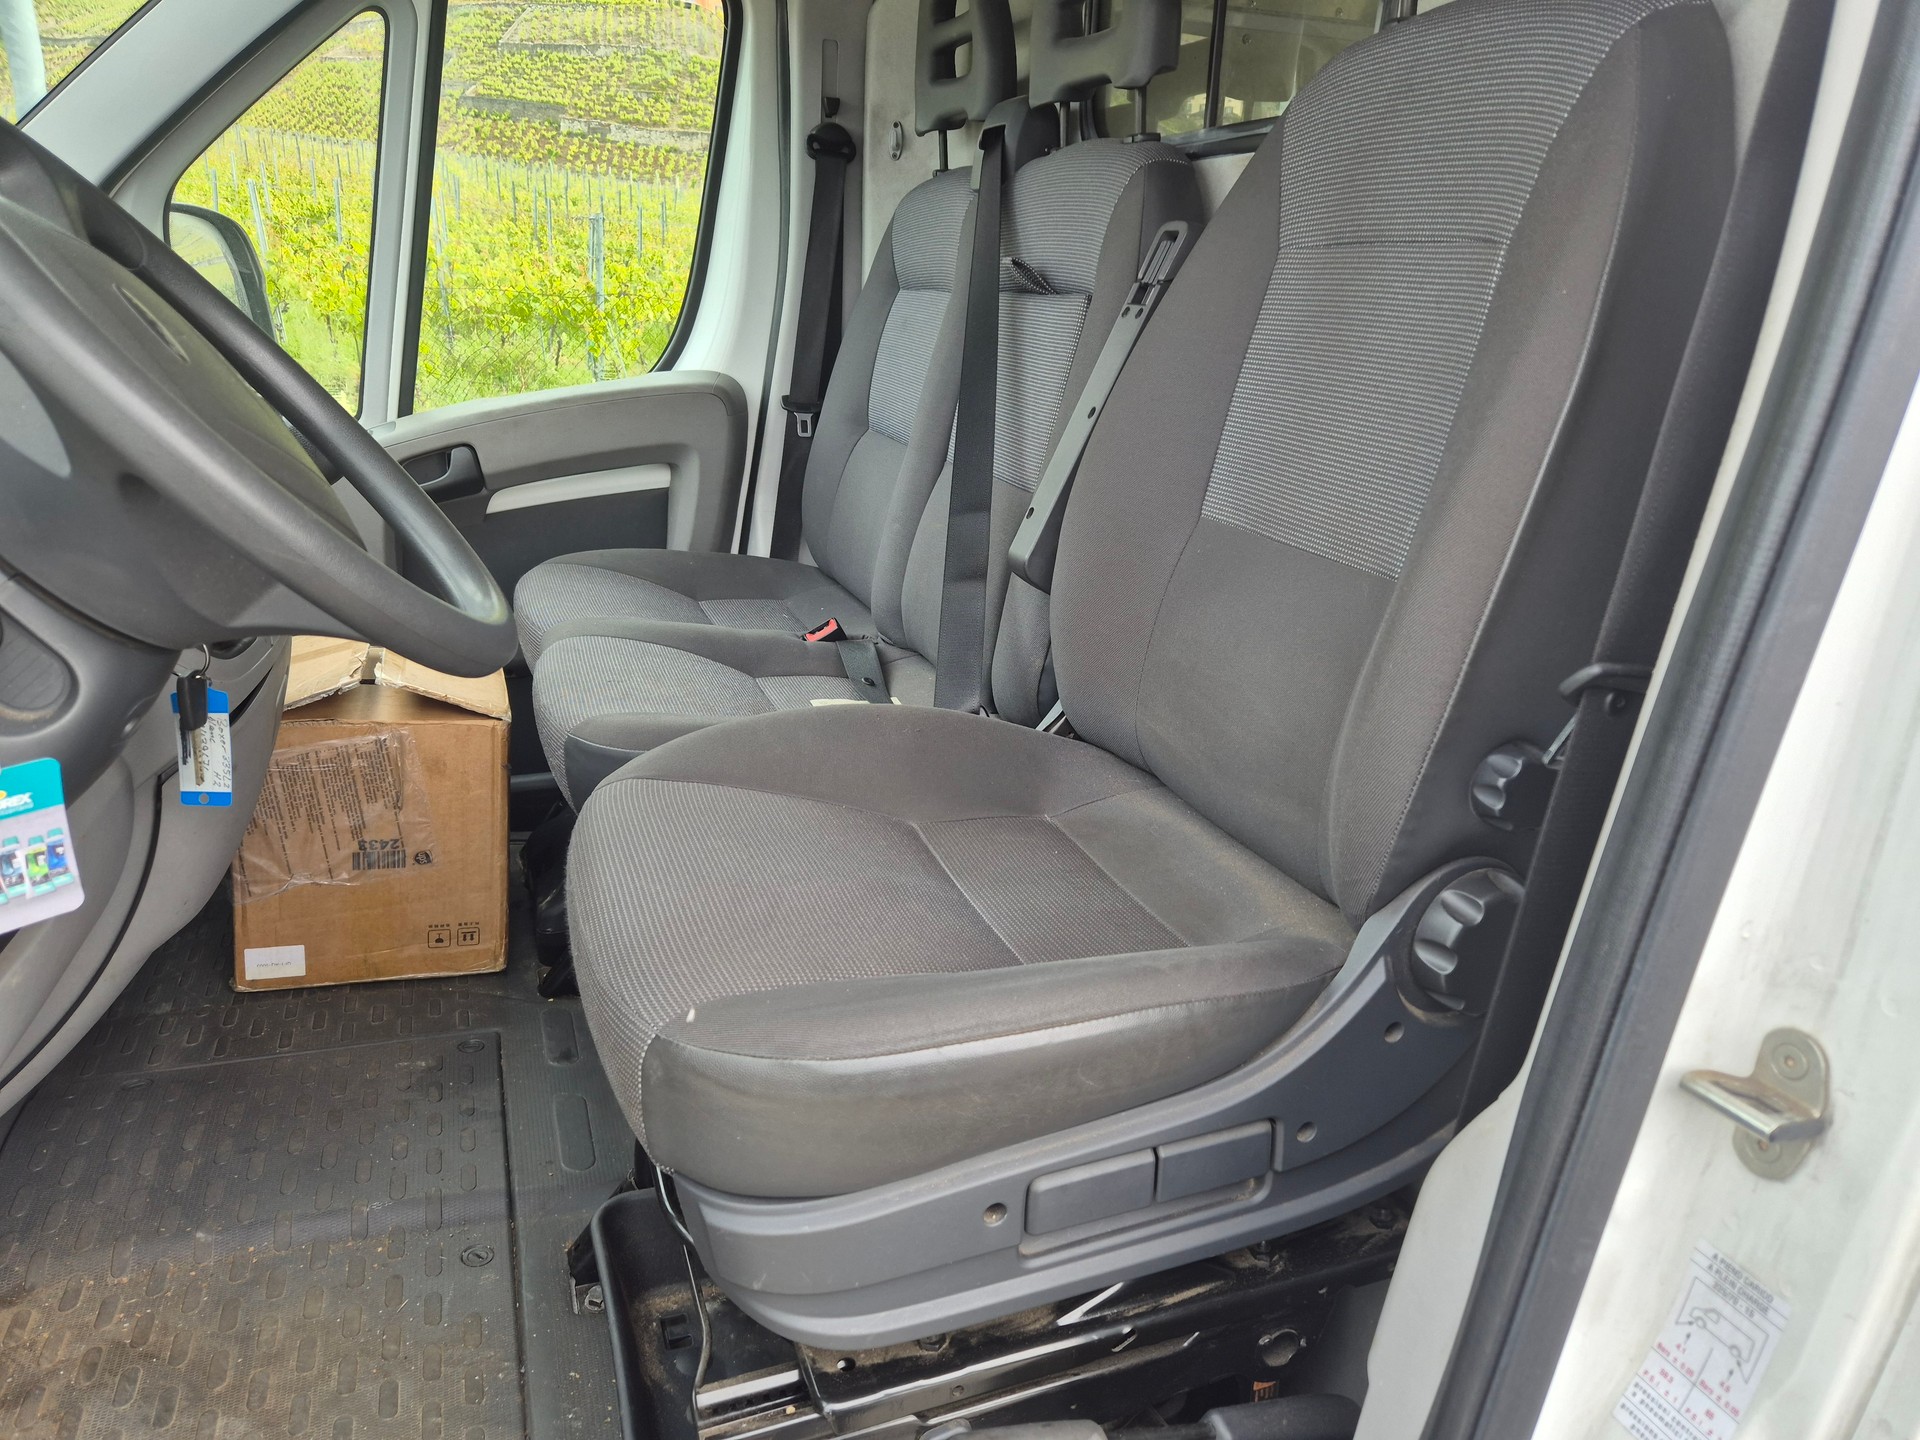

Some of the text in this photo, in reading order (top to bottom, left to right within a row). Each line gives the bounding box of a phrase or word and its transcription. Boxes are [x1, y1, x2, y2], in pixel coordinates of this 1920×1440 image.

[1719, 1258, 1743, 1280] PIENO
[1714, 1268, 1738, 1290] PLEIN
[1737, 1286, 1770, 1316] CHARGE
